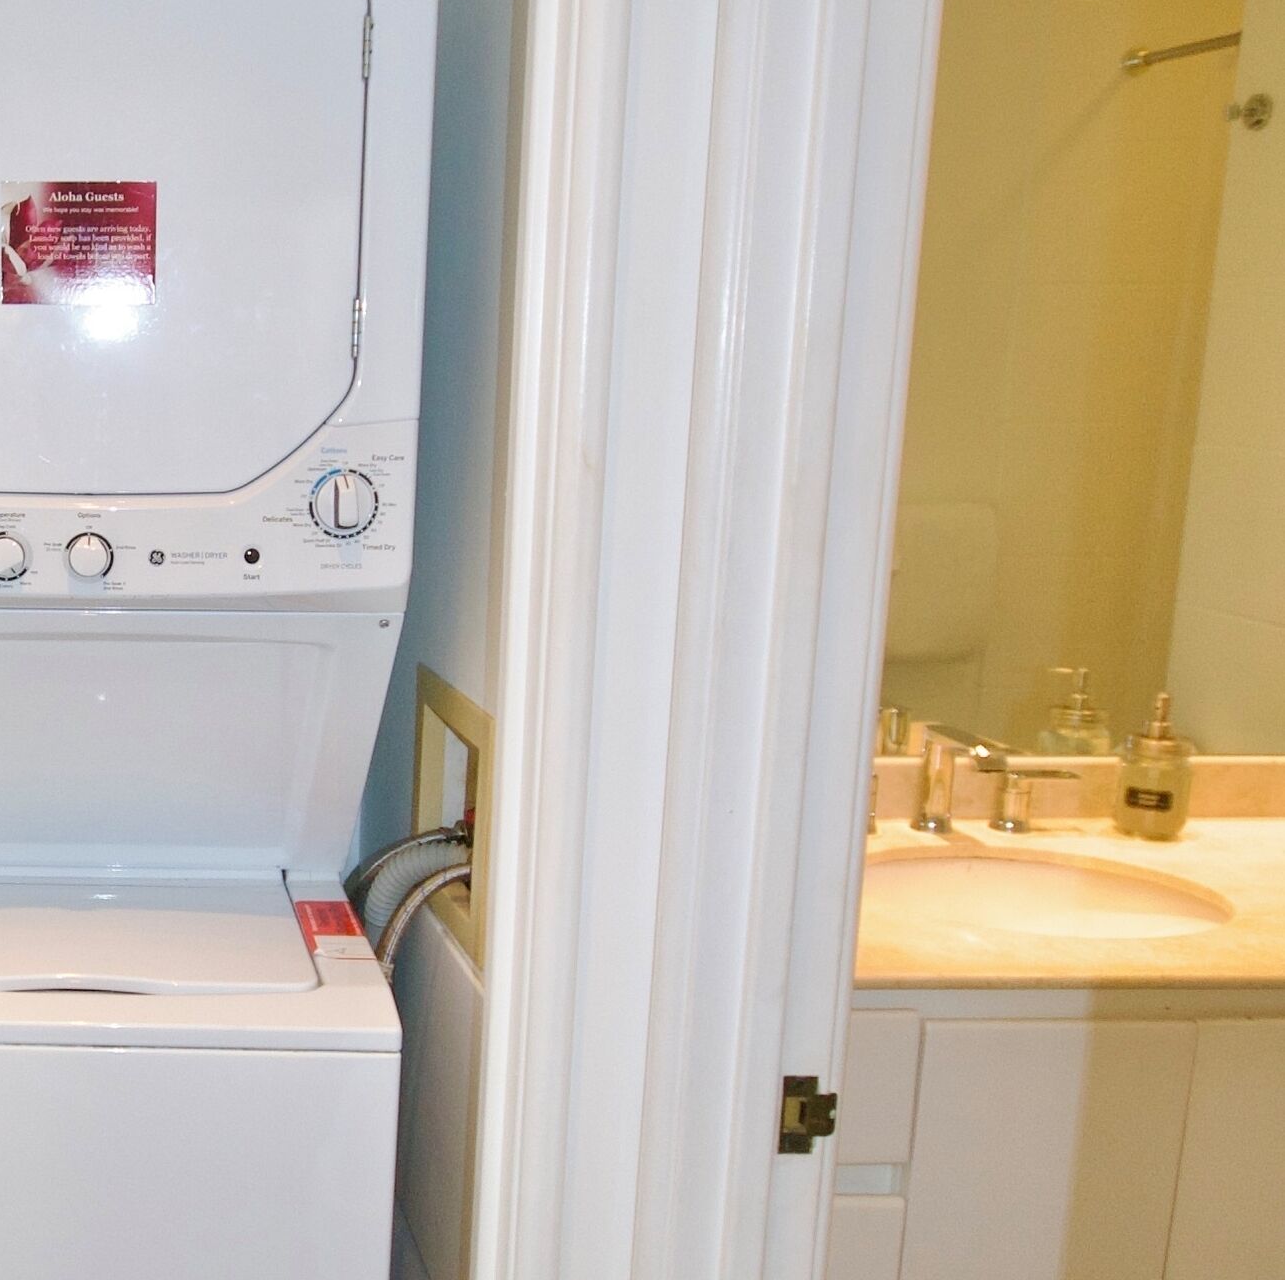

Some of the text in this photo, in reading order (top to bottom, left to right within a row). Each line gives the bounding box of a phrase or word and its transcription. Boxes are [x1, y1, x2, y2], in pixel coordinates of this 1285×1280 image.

[49, 191, 124, 202] Aloha Guests
[62, 225, 85, 234] guests
[100, 224, 128, 234] arriving
[29, 234, 59, 244] Laundry
[78, 233, 91, 241] has
[92, 233, 109, 241] been
[146, 233, 152, 241] if
[33, 244, 47, 252] you
[48, 242, 70, 251] would
[71, 242, 80, 251] be
[126, 242, 146, 251] wash
[371, 454, 387, 462] Easy
[362, 543, 396, 551] Timed Dry
[243, 573, 260, 581] Start
